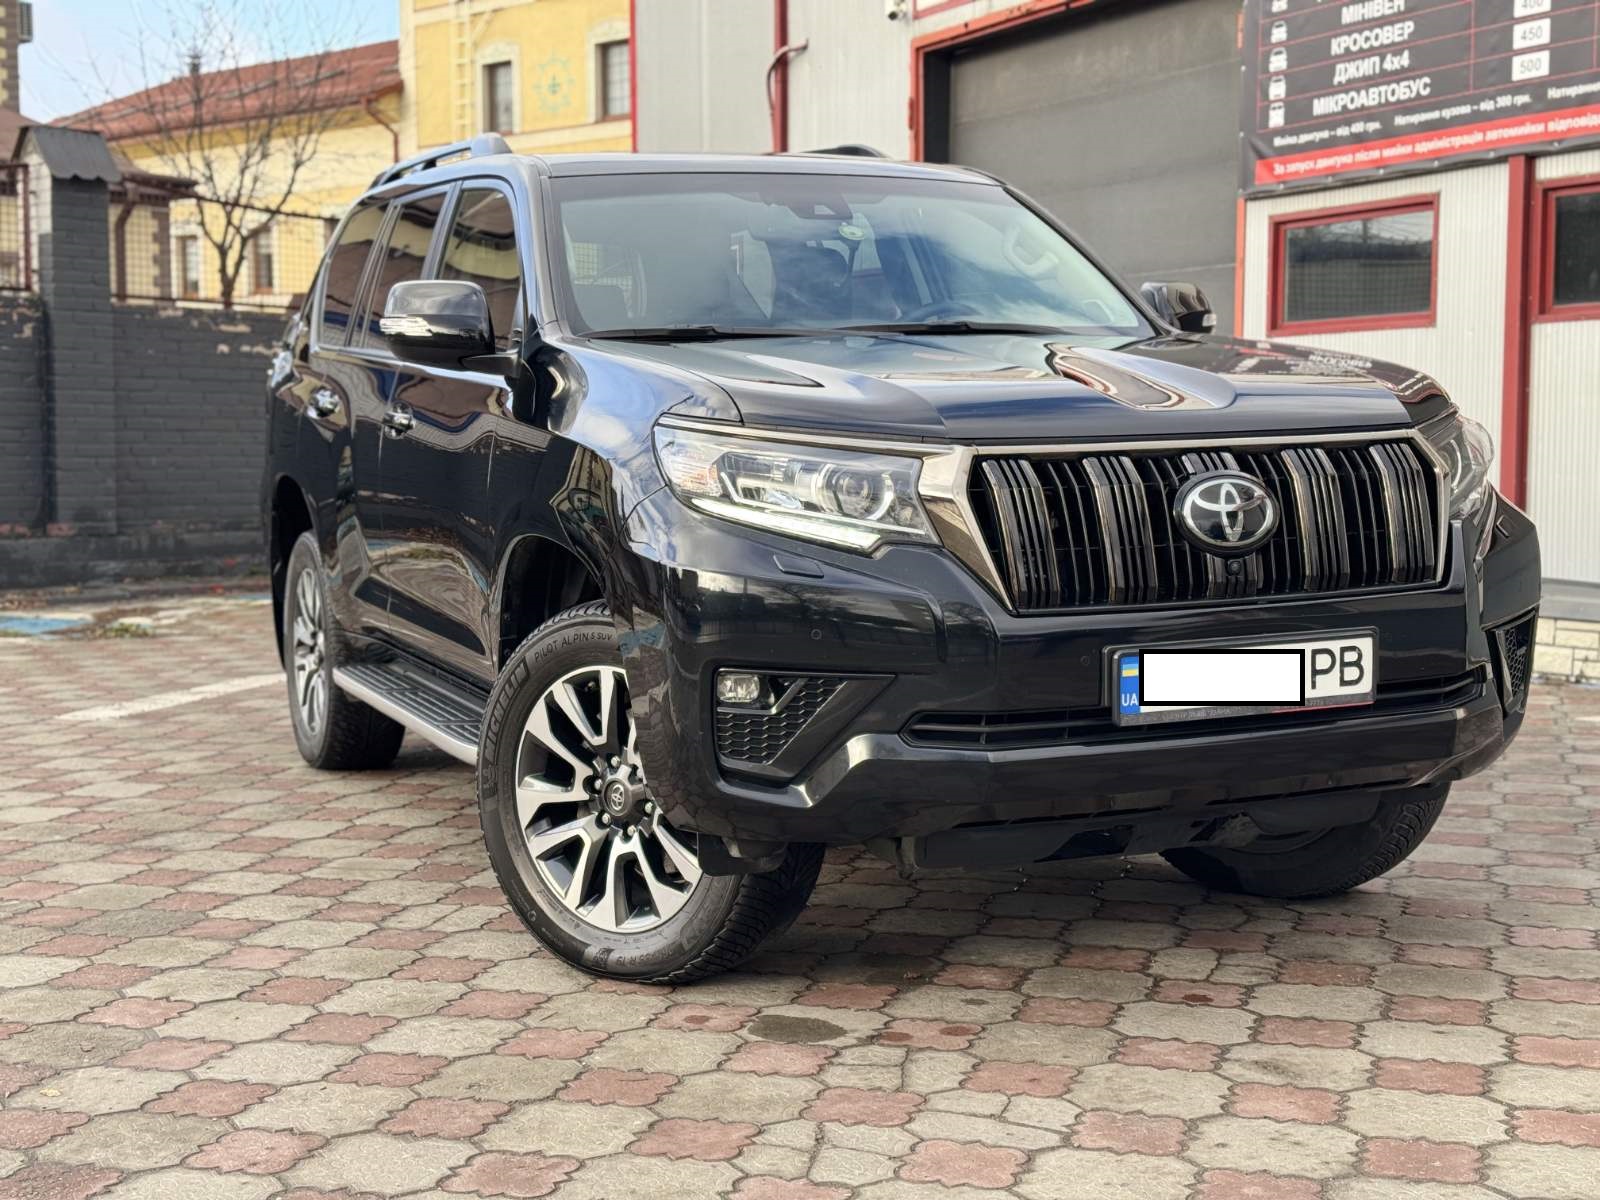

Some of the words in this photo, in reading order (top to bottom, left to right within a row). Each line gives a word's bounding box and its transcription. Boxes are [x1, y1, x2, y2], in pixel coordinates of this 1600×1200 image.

[1341, 0, 1405, 25] МІНІВЕН
[1330, 20, 1415, 56] КРОСОВЕР
[1520, 25, 1543, 41] 450
[1333, 55, 1380, 86] ДЖИП
[1519, 57, 1542, 75] 500
[1312, 76, 1432, 116] МІКРОАВТОБУС
[1273, 162, 1285, 176] За
[533, 639, 559, 663] PILOT
[561, 632, 589, 648] ALPIN
[596, 632, 613, 641] SUV
[1310, 645, 1365, 690] PB
[1121, 692, 1138, 707] UA
